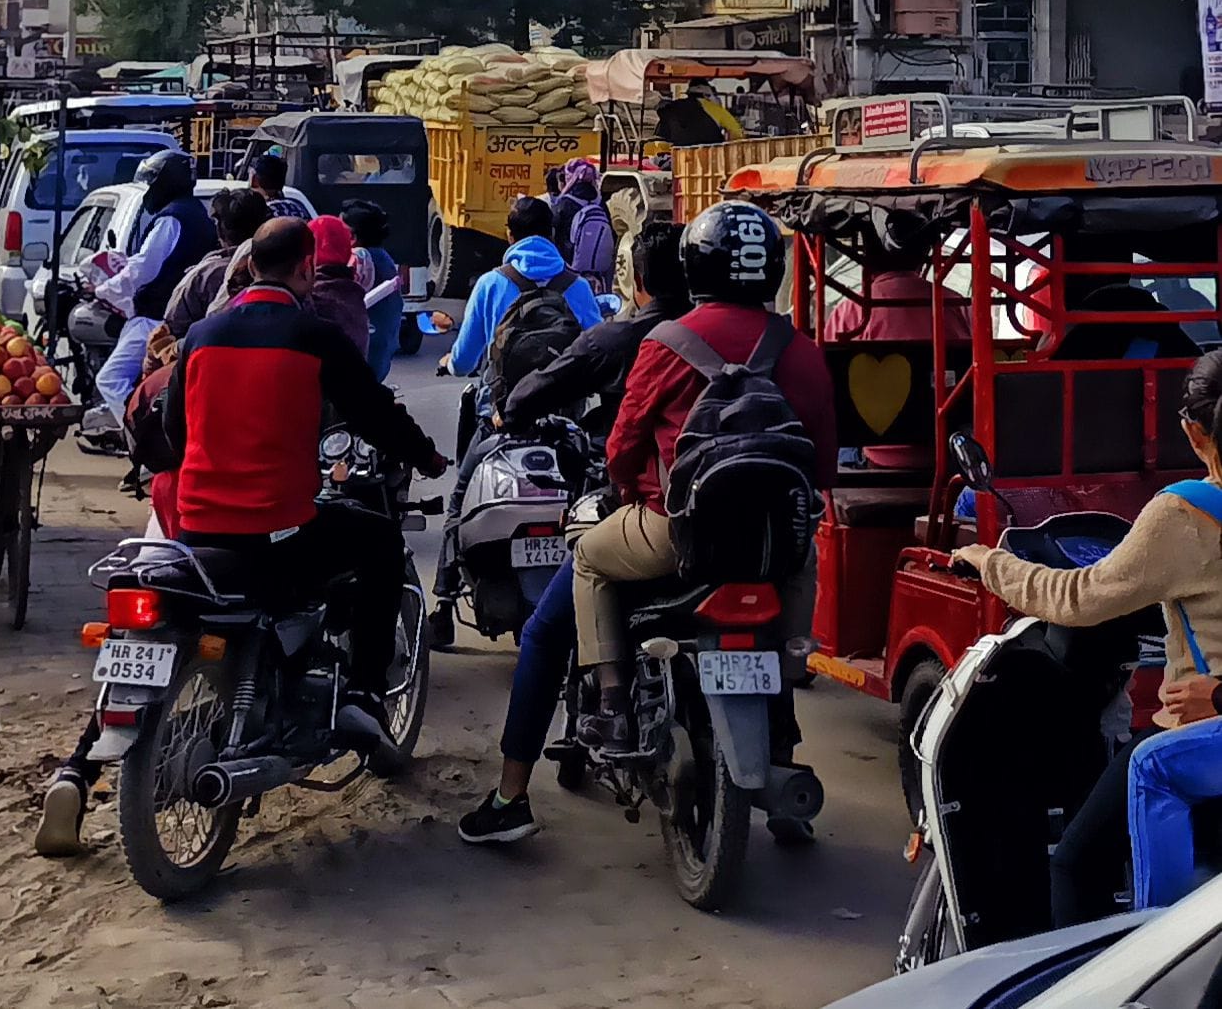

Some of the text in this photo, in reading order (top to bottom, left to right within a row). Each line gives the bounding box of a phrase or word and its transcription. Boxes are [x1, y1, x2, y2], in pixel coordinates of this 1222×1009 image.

[487, 129, 582, 157] अल्ट्राटेक
[736, 212, 767, 280] 1901
[111, 644, 131, 659] HR
[135, 646, 154, 660] 24
[110, 662, 155, 680] 0534
